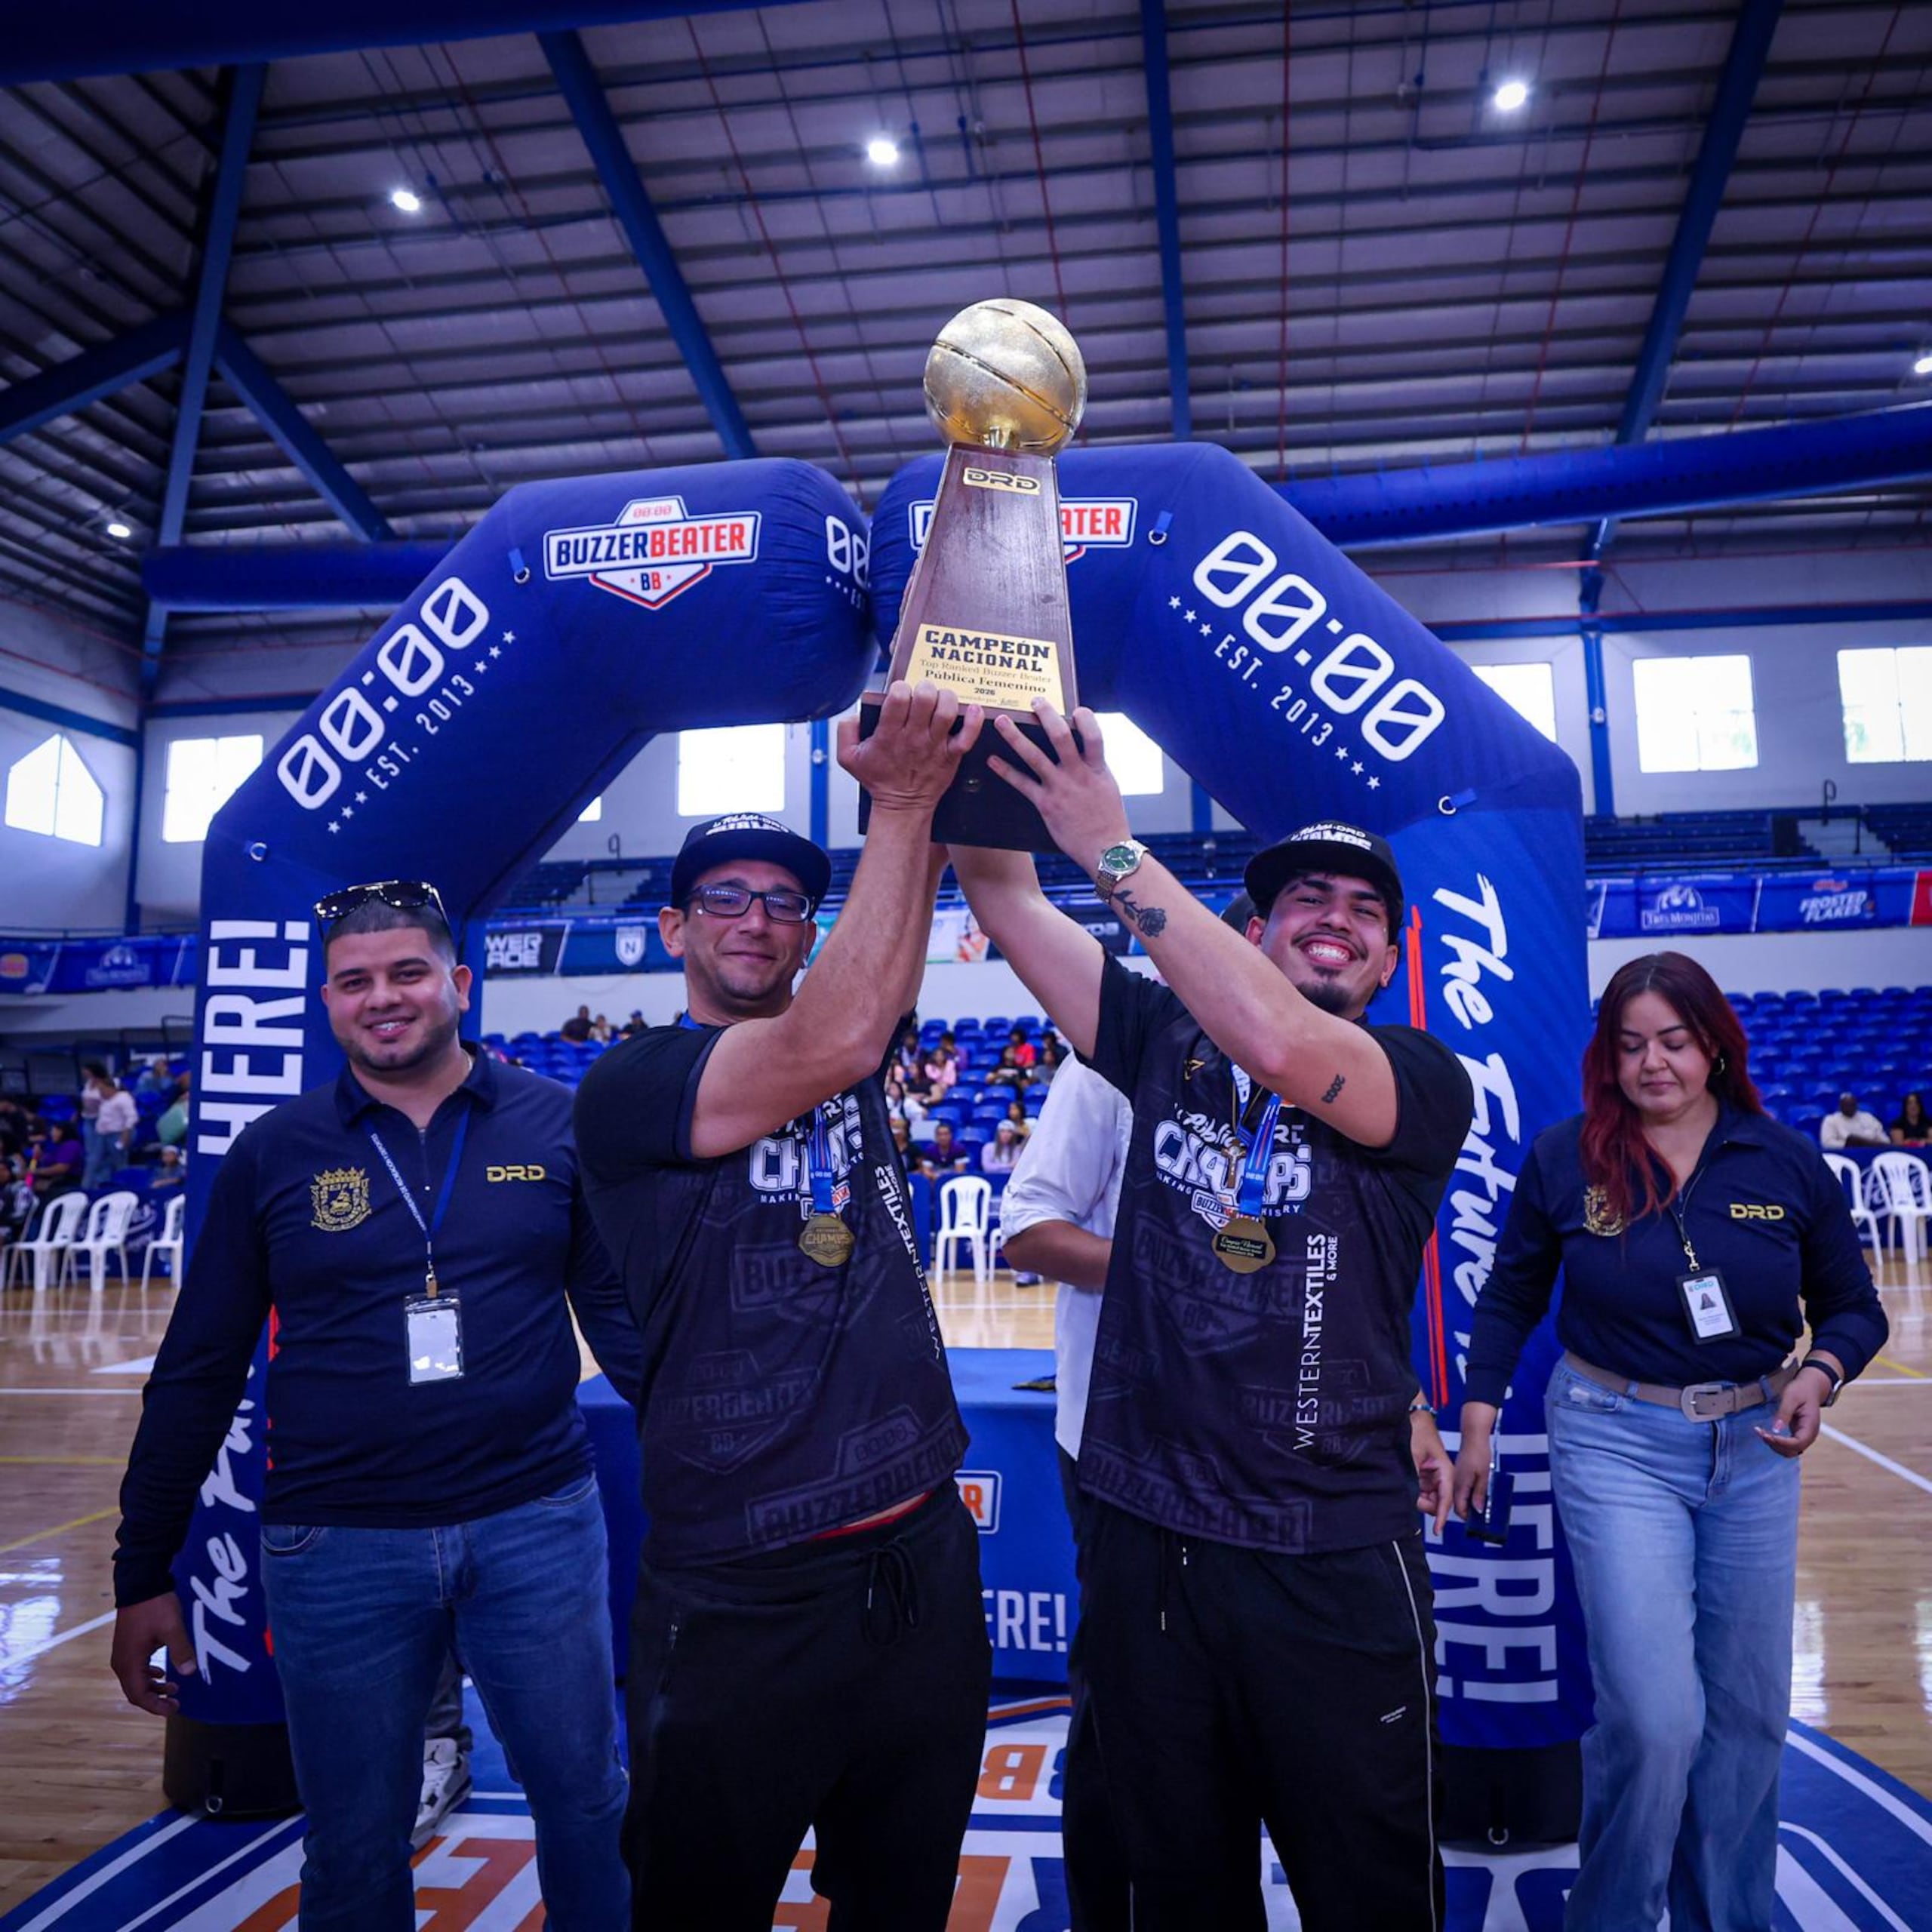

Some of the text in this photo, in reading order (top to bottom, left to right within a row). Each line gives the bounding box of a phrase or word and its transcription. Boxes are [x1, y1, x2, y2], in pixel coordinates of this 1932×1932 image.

[967, 469, 1038, 490] DRD
[556, 522, 746, 566] BUZZERBEATER
[640, 571, 662, 592] BB
[925, 630, 1051, 659] CAMPEÓN
[931, 646, 1043, 673] NACIONAL
[1193, 531, 1446, 762] 00:00
[942, 663, 980, 674] Ranked
[980, 676, 1047, 694] Femenino
[277, 577, 490, 811] 00:00
[1214, 634, 1334, 747] EST. 2013
[365, 674, 475, 790] EST. 2013
[1800, 891, 1868, 913] FROSTED
[1432, 872, 1514, 1030] The
[198, 920, 309, 1155] HERE!
[486, 1164, 546, 1183] DRD
[1730, 1204, 1785, 1220] DRD
[1327, 1235, 1338, 1271] MORE
[1293, 1233, 1327, 1451] WESTERNTEXTILES
[190, 1531, 252, 1685] The
